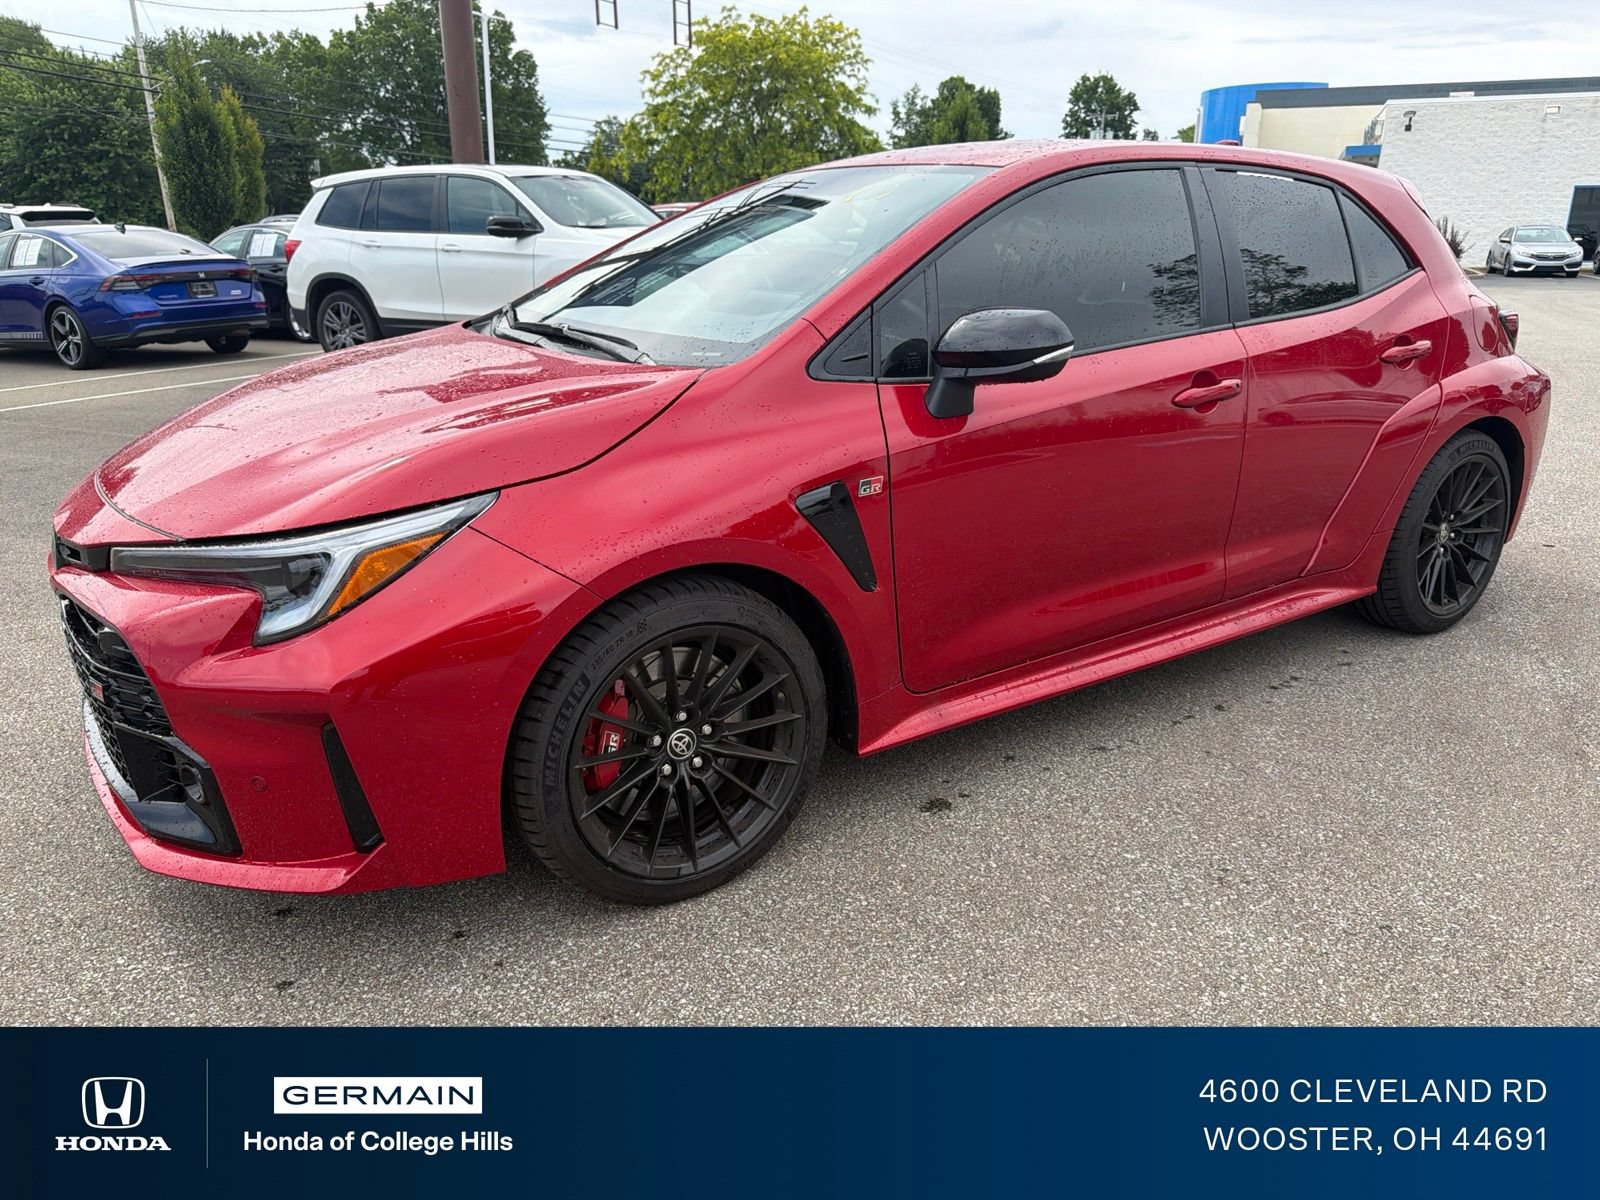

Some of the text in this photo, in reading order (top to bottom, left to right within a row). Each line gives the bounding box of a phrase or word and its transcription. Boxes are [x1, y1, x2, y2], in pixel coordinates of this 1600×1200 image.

[860, 481, 881, 496] GR
[614, 636, 625, 647] ZR
[544, 678, 588, 787] MICHELIN
